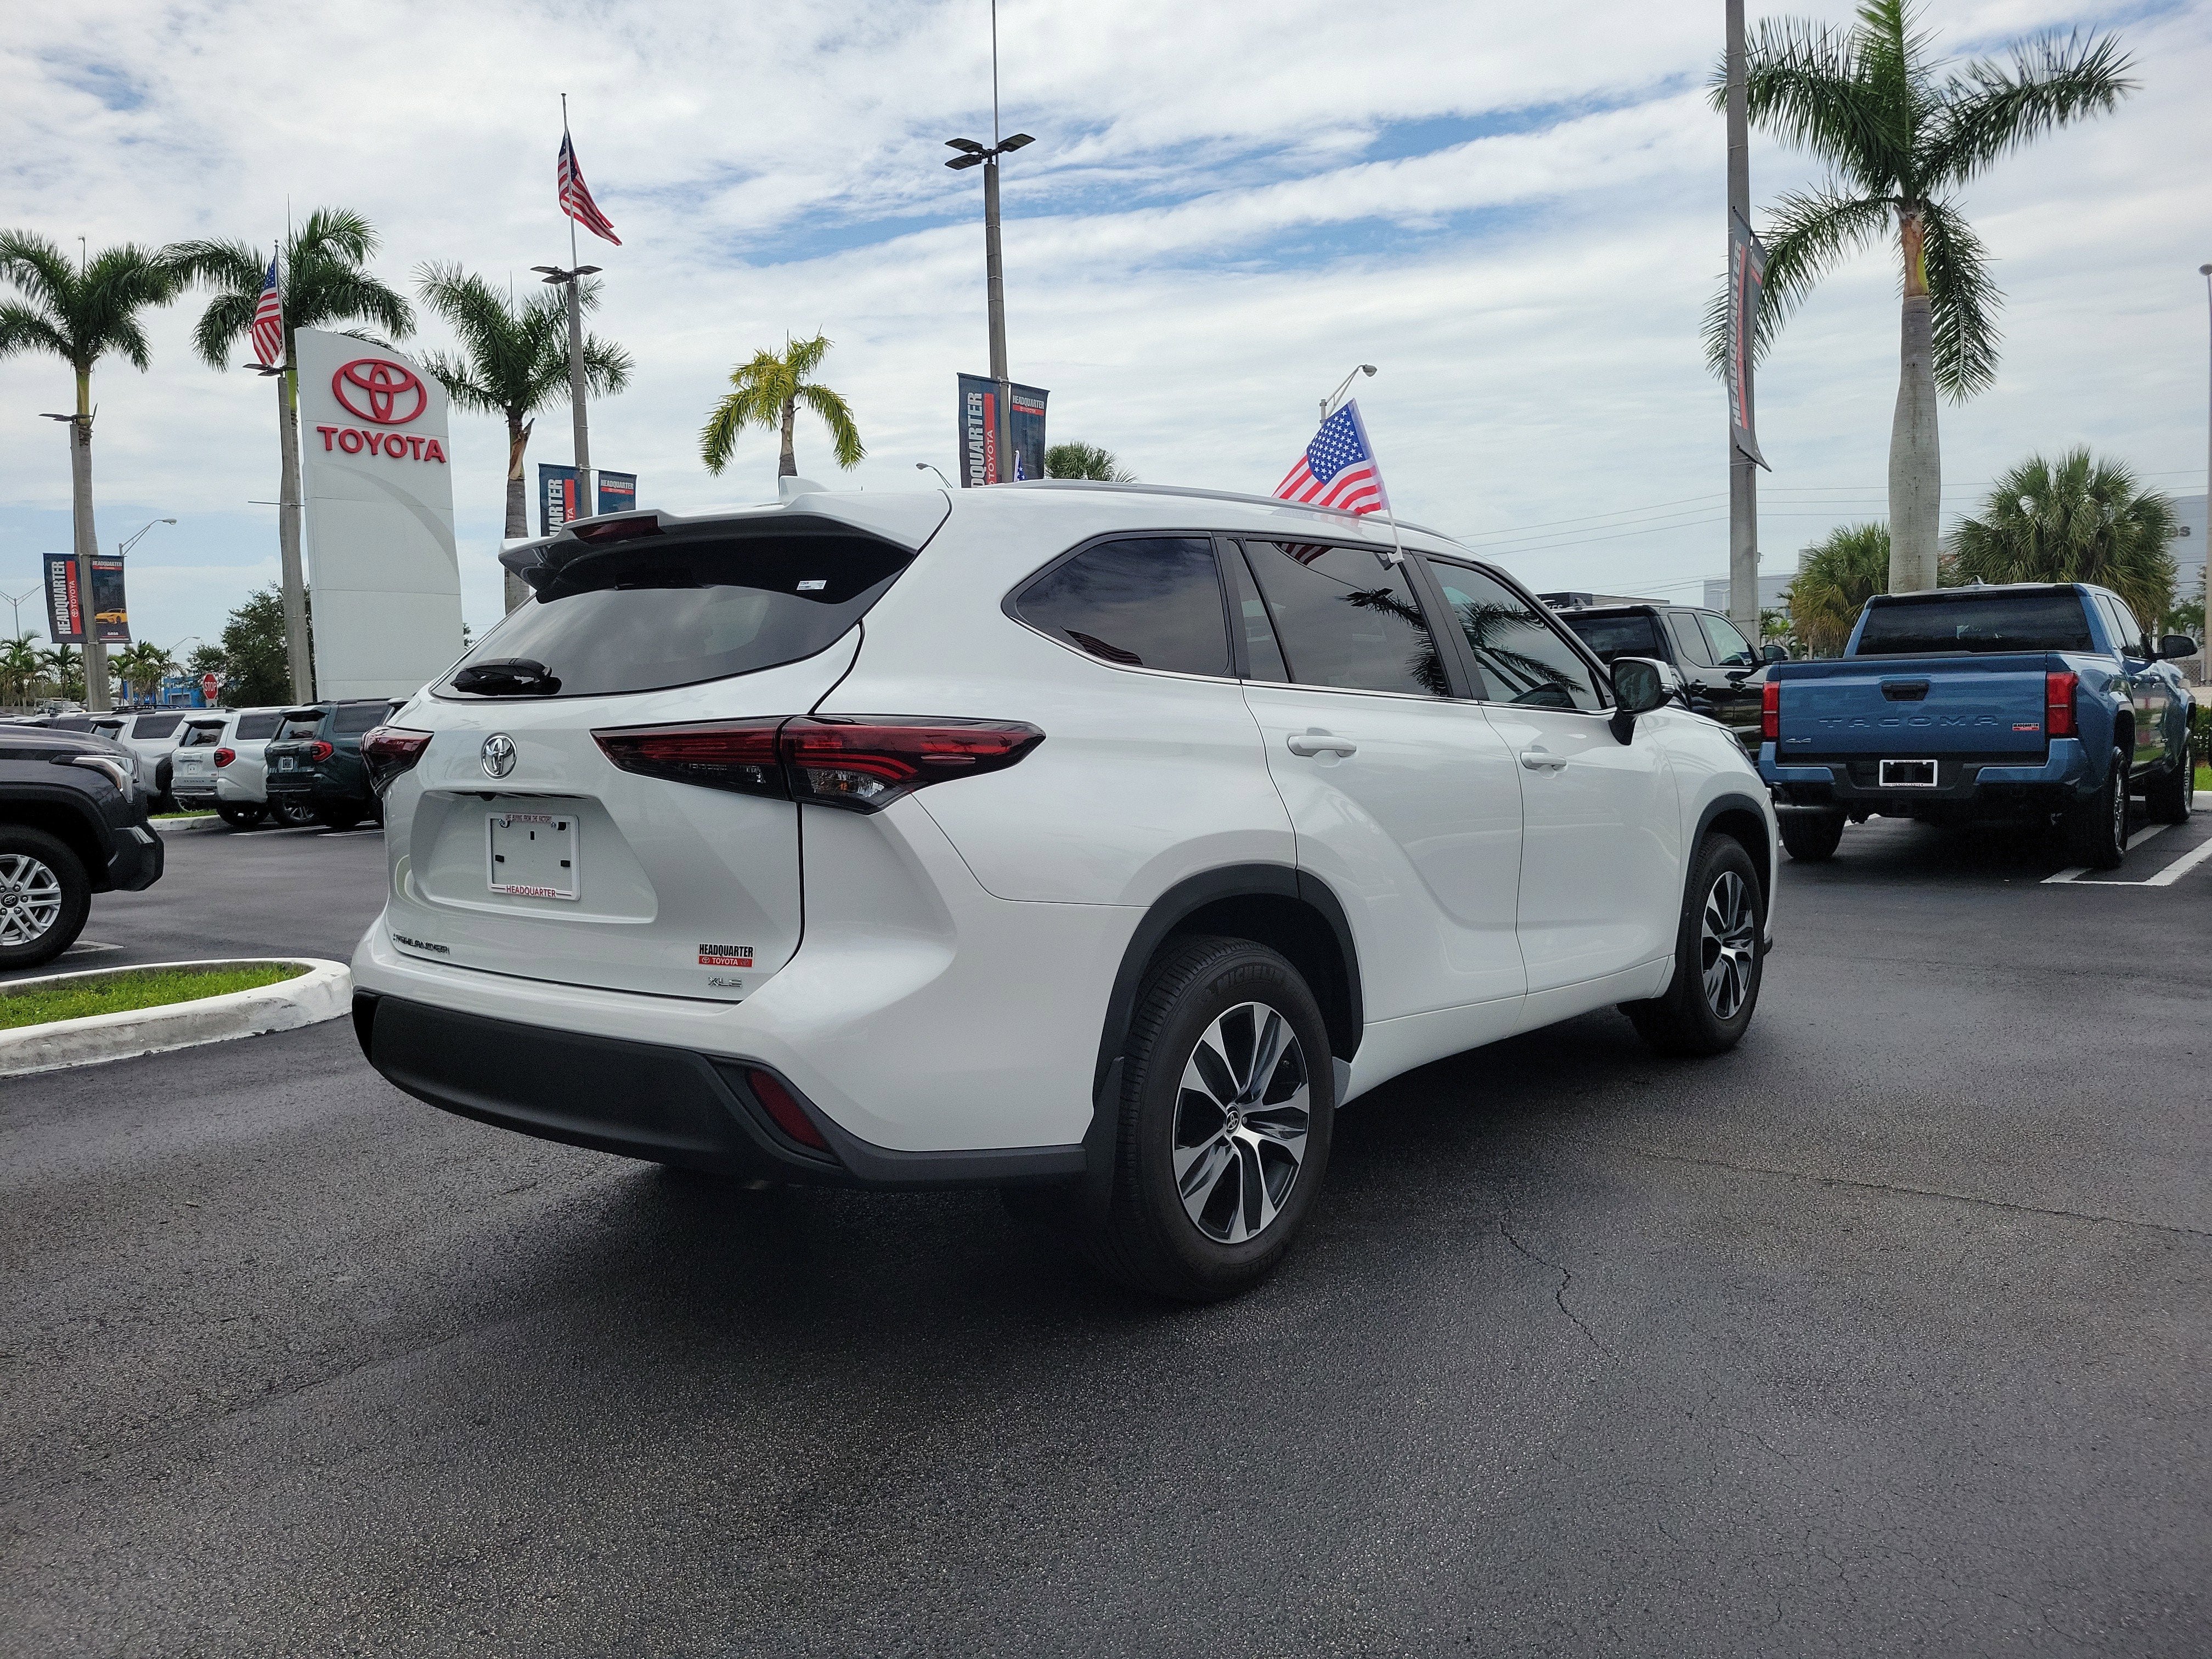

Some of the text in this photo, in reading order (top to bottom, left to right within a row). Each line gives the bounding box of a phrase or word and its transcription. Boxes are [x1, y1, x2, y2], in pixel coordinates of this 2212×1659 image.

[1729, 240, 1742, 426] HEADQUARTER
[1013, 395, 1044, 409] HEADQUARTER
[317, 426, 447, 463] TOYOTA
[601, 479, 634, 489] HEADQUARTER
[52, 561, 71, 634] HEADQUARTER
[69, 580, 78, 607] TOYOTA
[204, 681, 217, 691] STOP
[1819, 716, 1999, 728] TACOMA
[506, 885, 556, 897] HEADQUARTER
[699, 944, 753, 957] HEADQUARTER
[712, 957, 738, 966] TOYOTA
[708, 977, 742, 988] XLE
